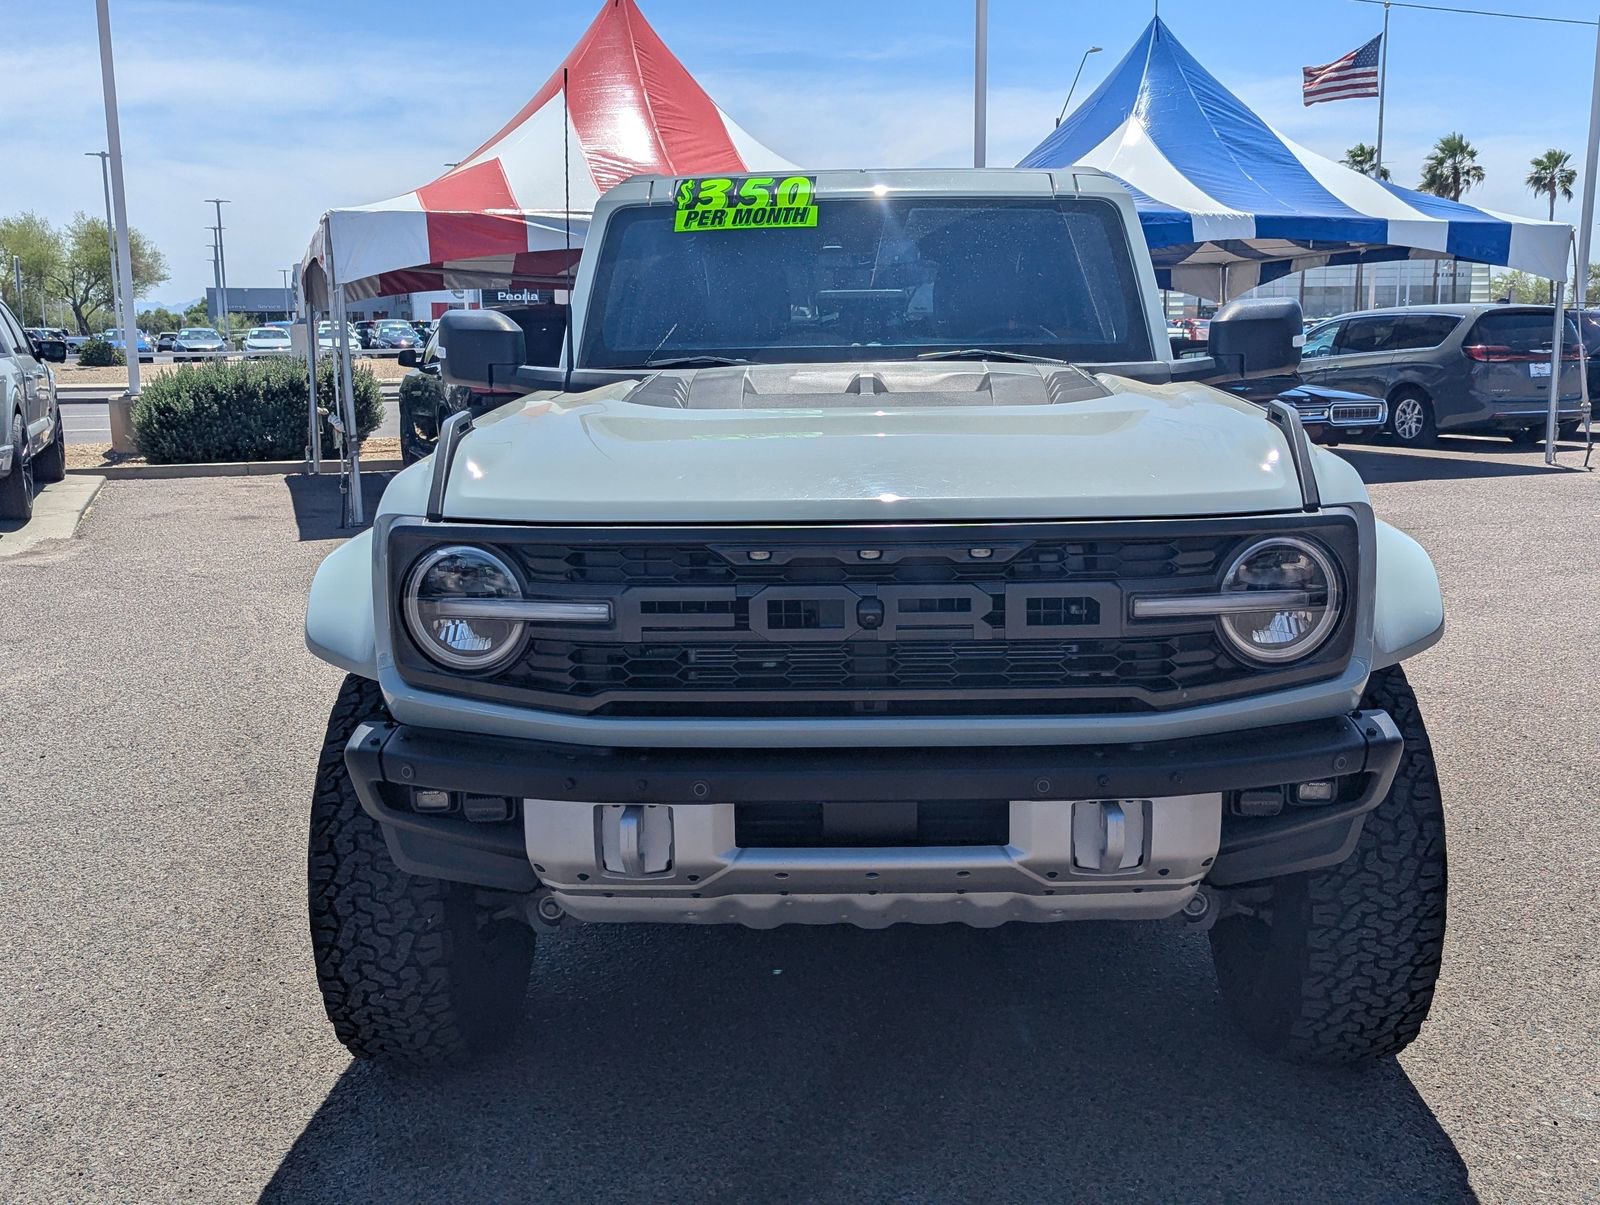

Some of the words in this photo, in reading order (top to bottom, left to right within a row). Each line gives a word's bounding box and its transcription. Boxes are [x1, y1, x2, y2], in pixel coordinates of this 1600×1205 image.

[676, 176, 813, 210] $350
[684, 208, 728, 229] PER
[732, 206, 811, 227] MONTH
[497, 291, 539, 301] Peoria
[620, 584, 1121, 643] FORD
